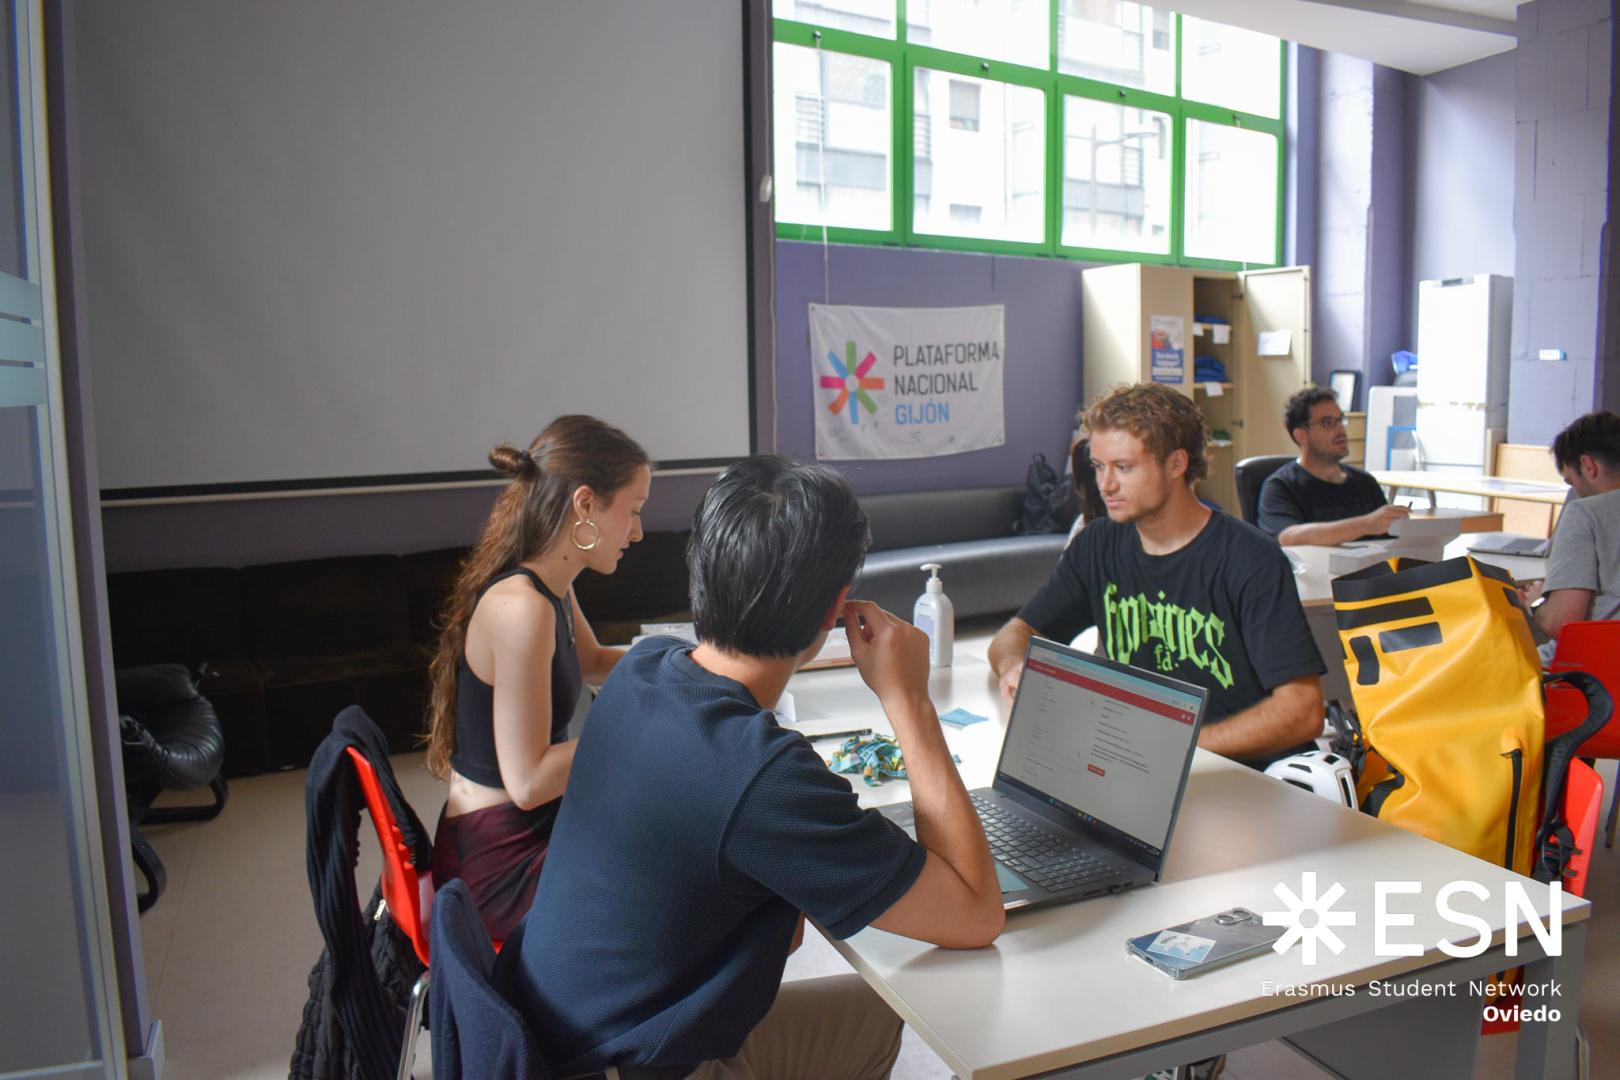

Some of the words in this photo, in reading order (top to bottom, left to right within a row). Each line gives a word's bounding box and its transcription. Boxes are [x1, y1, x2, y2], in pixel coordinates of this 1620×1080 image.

[893, 341, 1000, 366] PLATAFORMA
[894, 371, 978, 396] NACIONAL
[895, 399, 950, 426] GIJÓN
